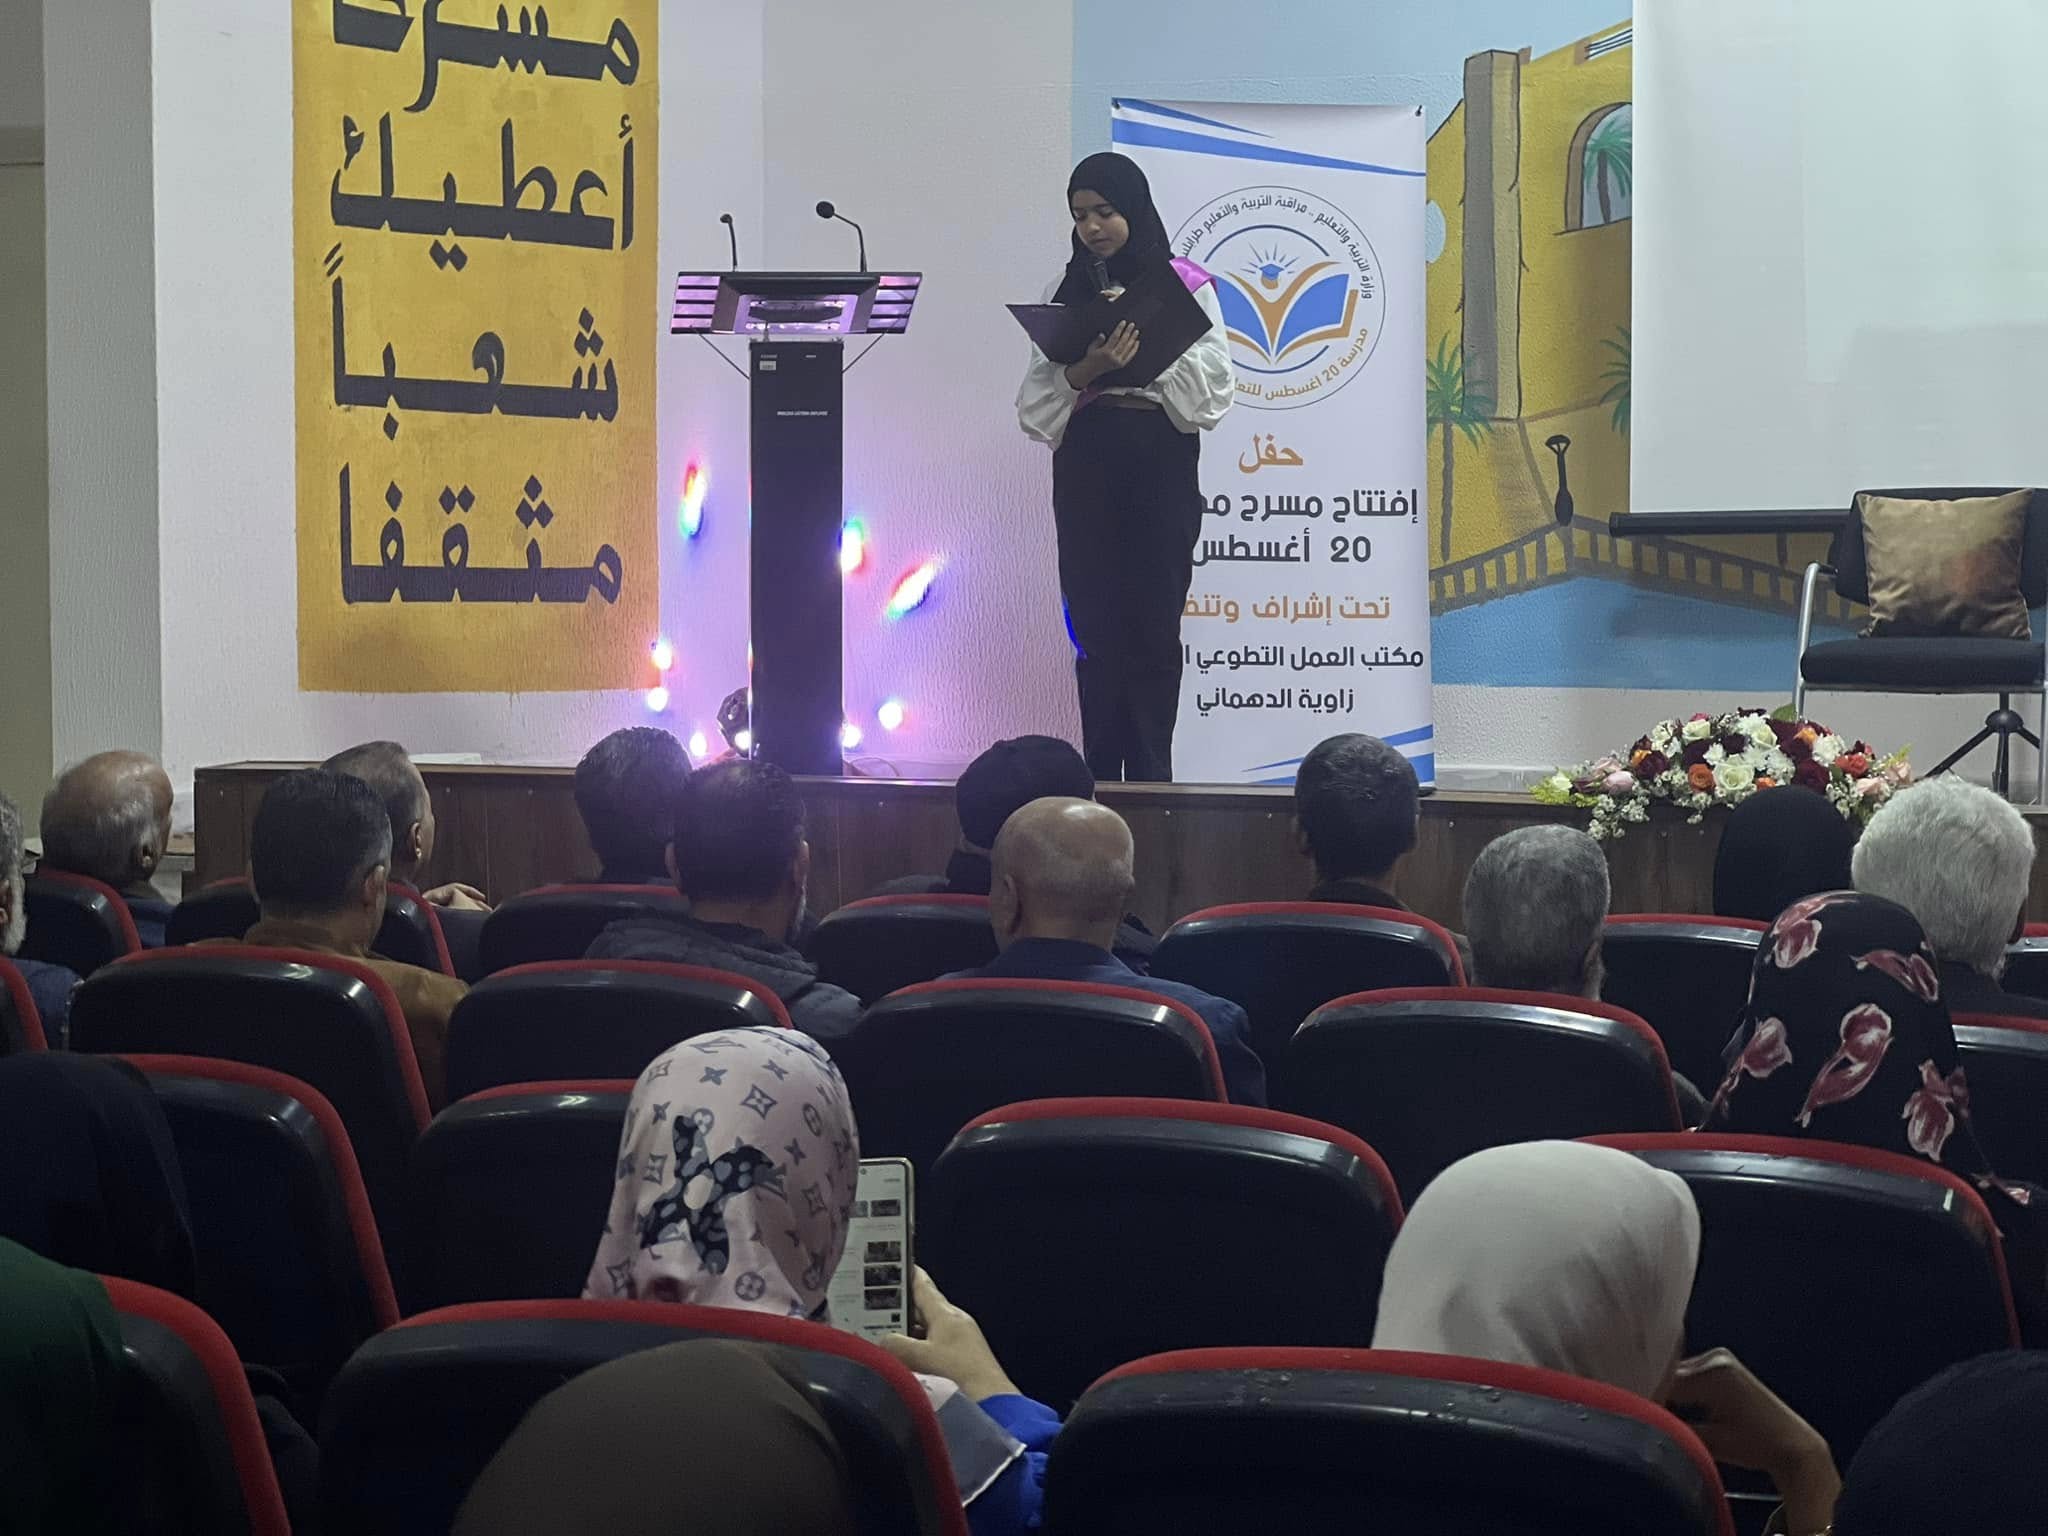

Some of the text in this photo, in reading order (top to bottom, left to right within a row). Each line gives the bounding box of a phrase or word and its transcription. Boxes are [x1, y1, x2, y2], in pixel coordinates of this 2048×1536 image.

[1241, 195, 1272, 211] التربية
[1275, 195, 1308, 213] مراقبة
[1202, 203, 1239, 234] والتعليم
[1314, 212, 1351, 244] والتعليم
[1348, 241, 1371, 273] التربية
[1361, 275, 1375, 299] وزارة
[1340, 328, 1368, 368] مدرسة
[1322, 364, 1340, 381] 20
[1238, 433, 1304, 474] حفل
[1240, 494, 1323, 522] مسرح
[1332, 489, 1418, 524] إفتتاح
[339, 462, 622, 604] مثقفا
[1192, 527, 1371, 567] 20 أغسطس
[1252, 592, 1332, 626] إشراف
[1339, 595, 1391, 619] تحت
[1196, 646, 1284, 674] التطوعي
[1291, 646, 1354, 671] العمل
[1361, 646, 1424, 671] مكتب
[1196, 687, 1354, 717] زاوية الدهماني
